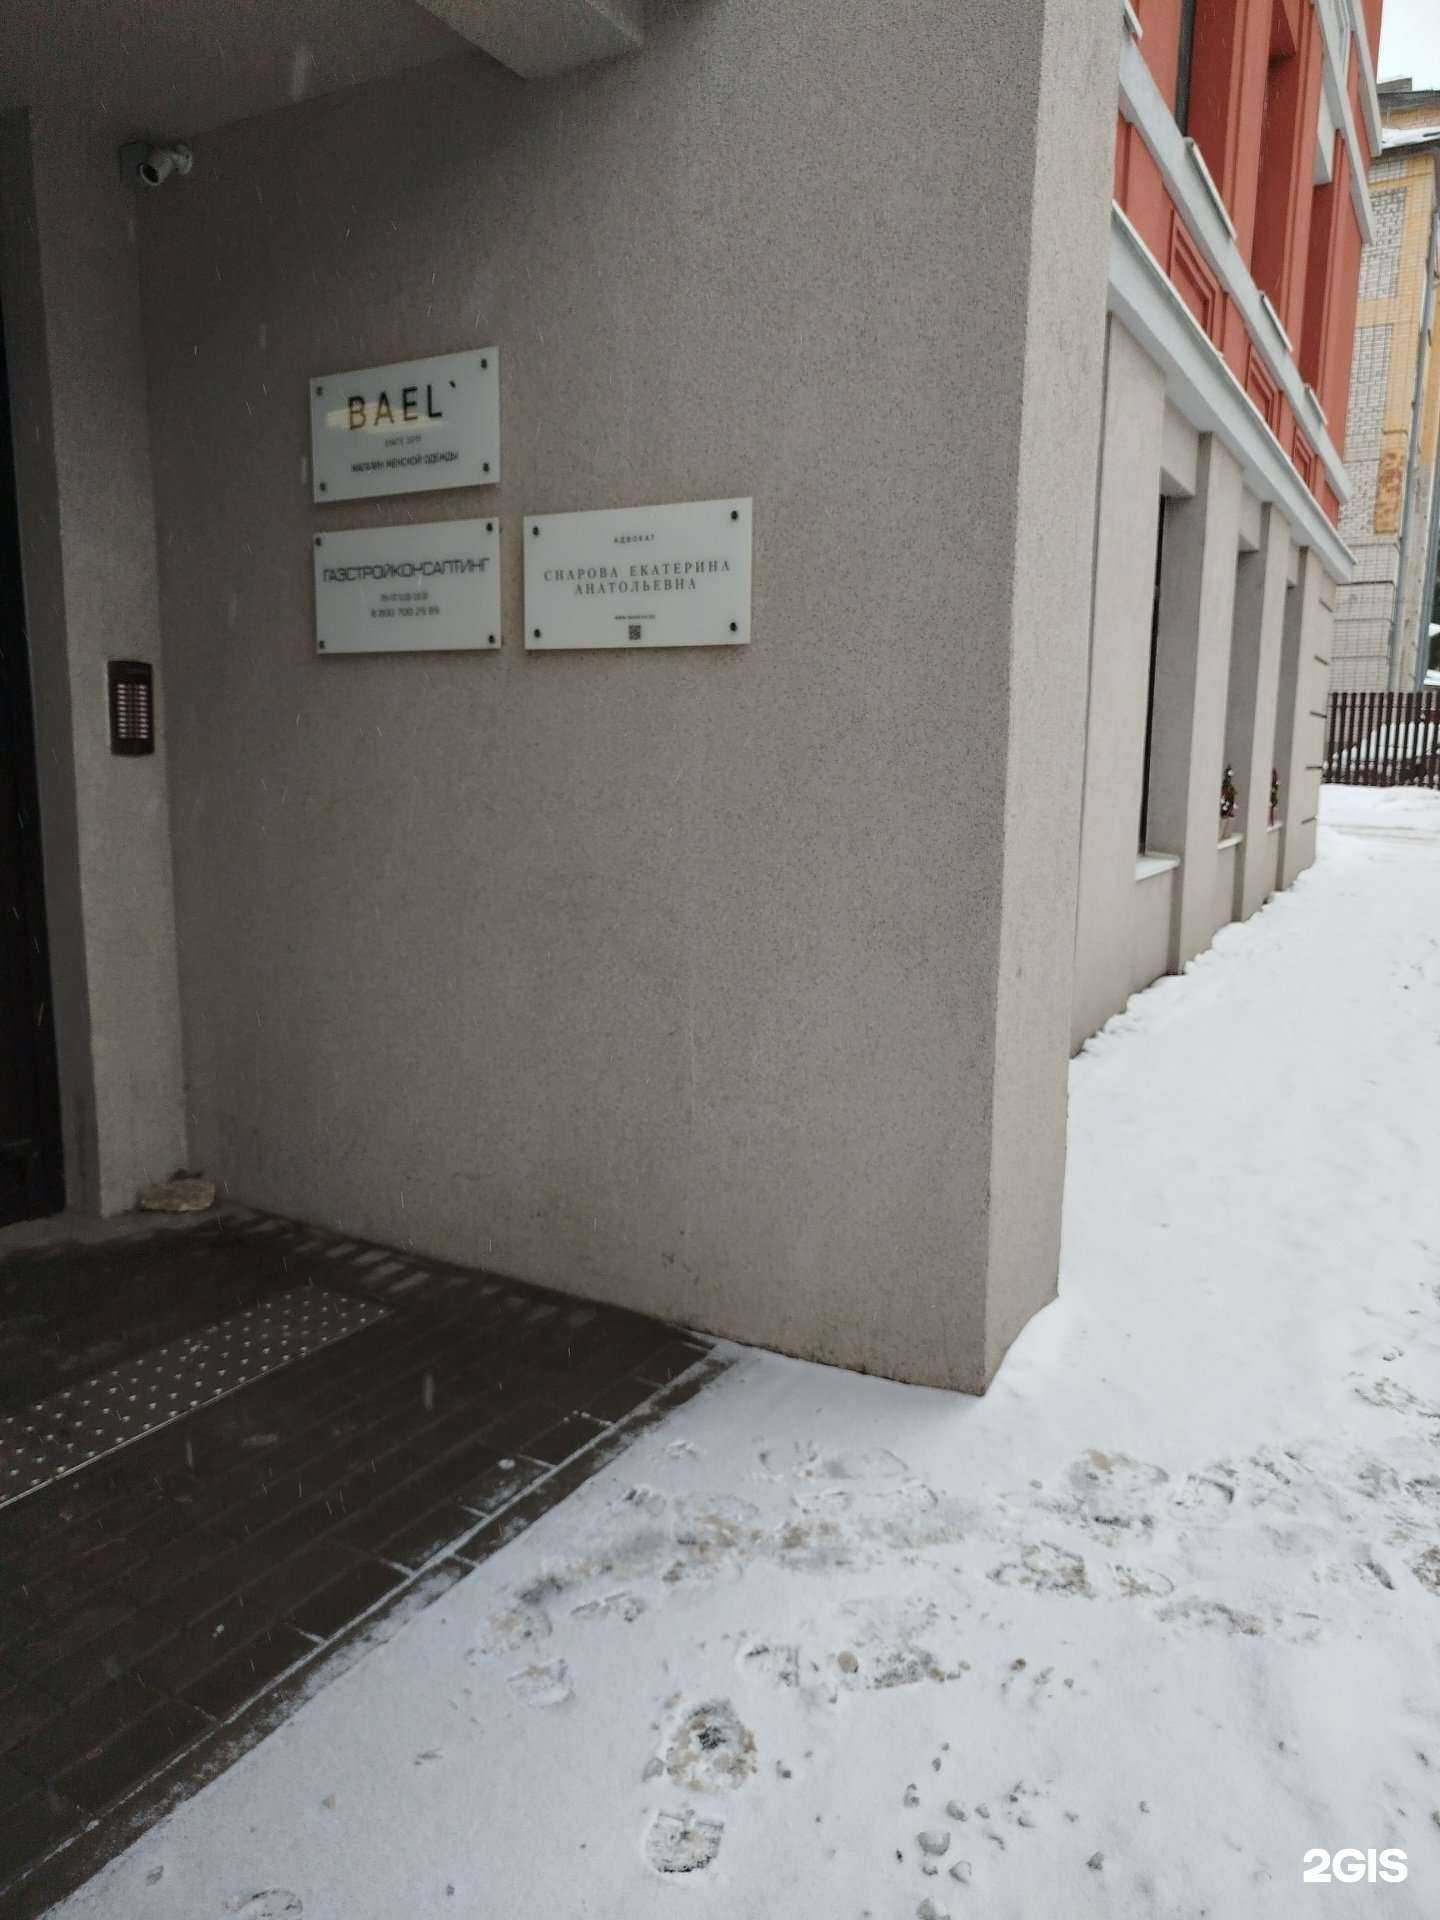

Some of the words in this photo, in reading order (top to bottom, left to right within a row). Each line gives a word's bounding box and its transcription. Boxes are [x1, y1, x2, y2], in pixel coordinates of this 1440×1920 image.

[613, 534, 655, 544] АДВОКАТ
[629, 560, 731, 577] ЕКАТЕРИНА
[574, 577, 697, 595] АНАТОЛЬЕВНА
